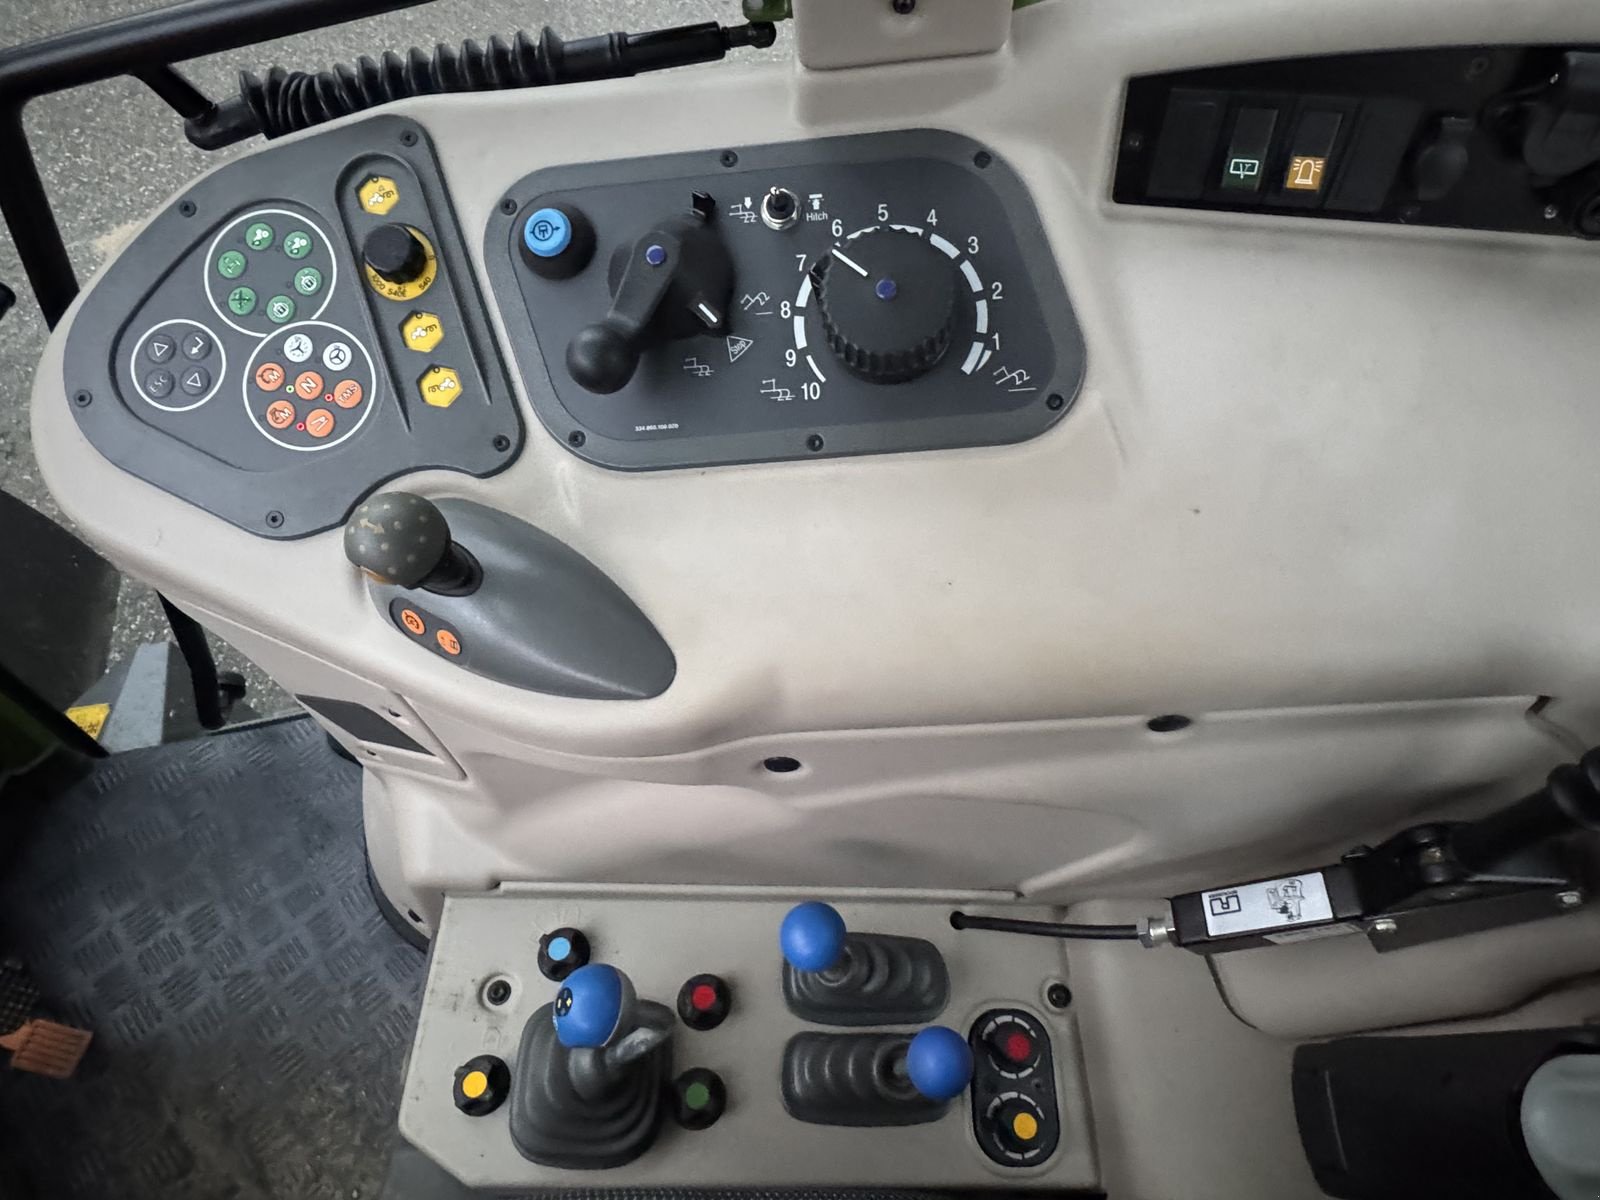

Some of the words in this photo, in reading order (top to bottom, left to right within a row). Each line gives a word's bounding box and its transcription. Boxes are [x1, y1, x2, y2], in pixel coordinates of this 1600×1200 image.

[806, 212, 829, 222] Hitch
[877, 203, 888, 222] 5
[926, 208, 938, 226] 4
[831, 218, 843, 237] 6
[967, 236, 979, 254] 3
[795, 254, 807, 272] 7
[418, 276, 432, 290] 540
[991, 281, 1003, 300] 2
[780, 300, 791, 319] 8
[991, 332, 1000, 350] 1
[785, 348, 797, 367] 9
[300, 376, 318, 394] N
[338, 383, 360, 403] TMS
[800, 381, 821, 400] 10
